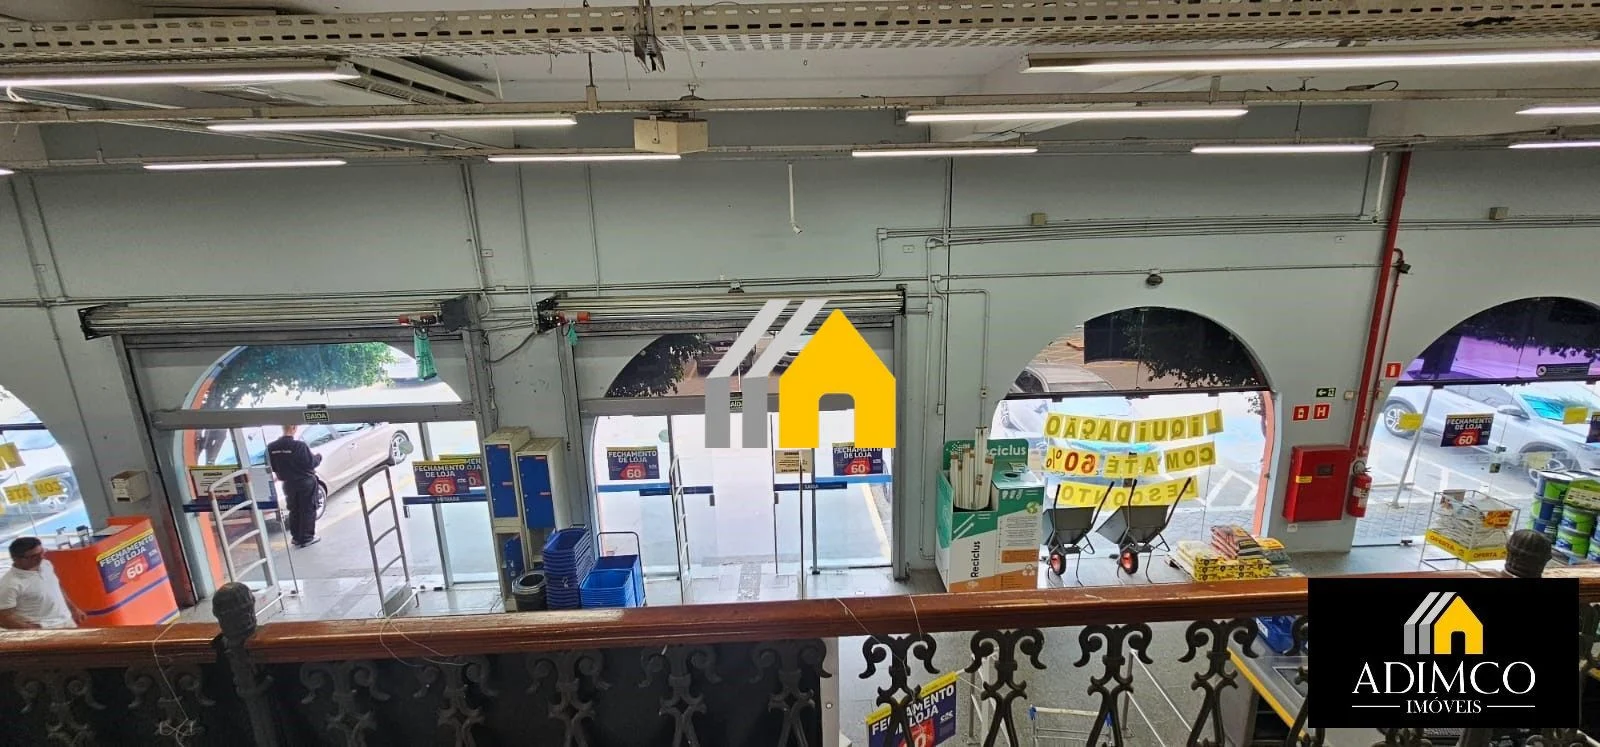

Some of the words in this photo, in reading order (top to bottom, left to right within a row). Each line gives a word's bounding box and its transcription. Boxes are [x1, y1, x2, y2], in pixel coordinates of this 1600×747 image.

[1317, 406, 1326, 417] H
[1447, 417, 1493, 425] FECHAMENTO
[608, 450, 657, 458] FECHAMENTO
[414, 464, 465, 472] FECHAMENTO
[436, 470, 456, 478] LOJA
[99, 534, 154, 567] FECHAMENTO
[113, 558, 127, 568] DE
[126, 546, 147, 561] LOJA
[970, 541, 981, 578] Reciclus
